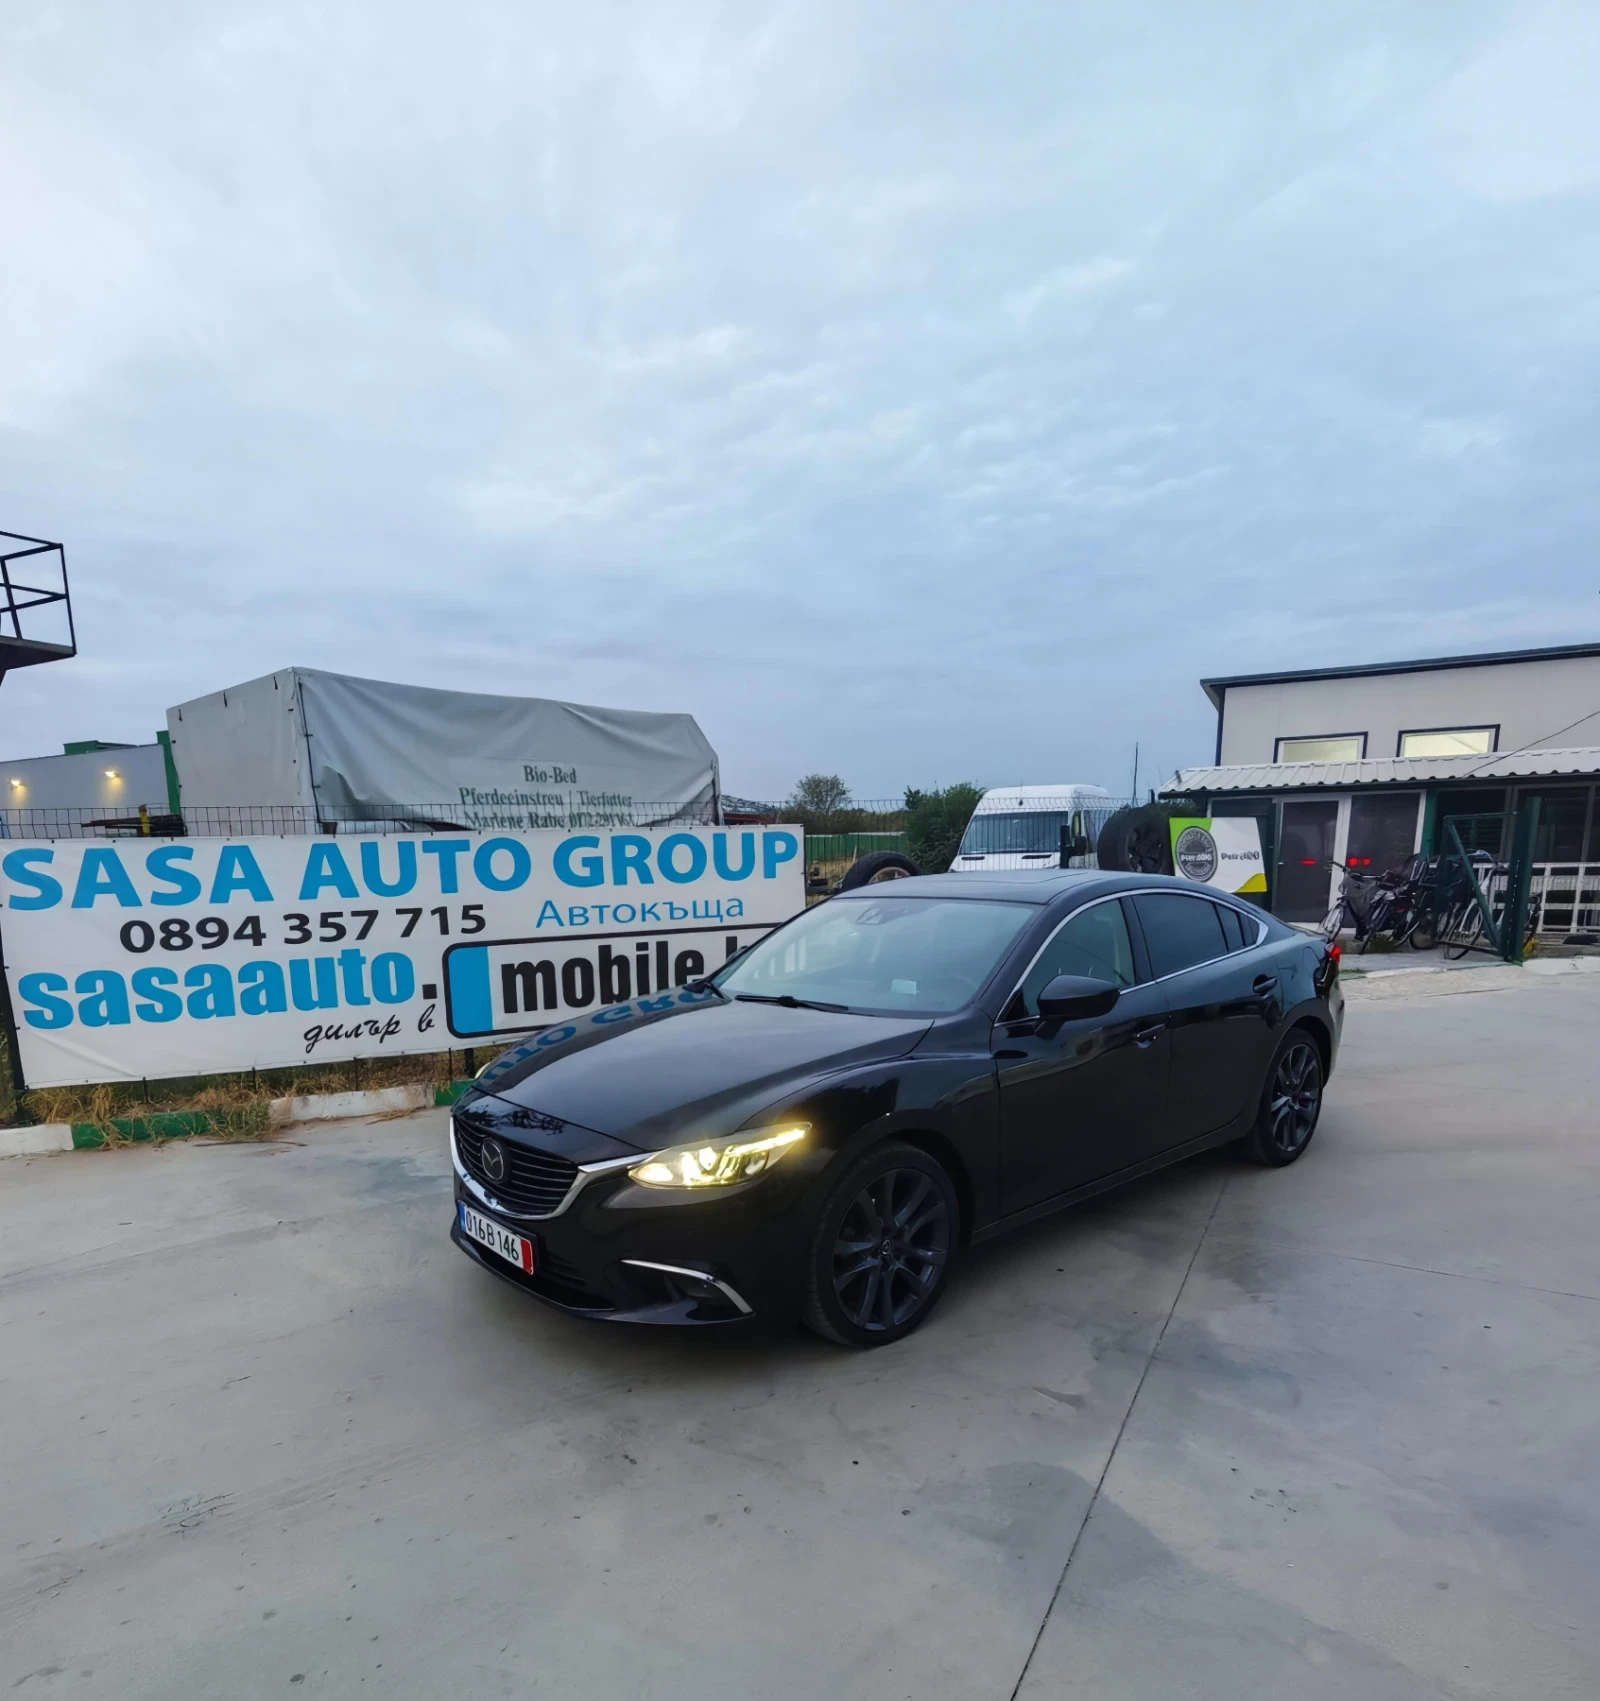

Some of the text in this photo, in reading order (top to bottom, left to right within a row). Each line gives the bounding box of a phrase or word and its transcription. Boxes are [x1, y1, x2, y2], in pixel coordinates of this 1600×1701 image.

[524, 765, 578, 784] Bio-Bed
[458, 787, 633, 808] Pferdeeinstreu Tierfutter
[2, 831, 799, 911] SASA AUTO GROUP
[120, 904, 486, 952] 0894 357 715
[536, 898, 744, 928] Автокъща
[303, 1015, 401, 1054] дилър
